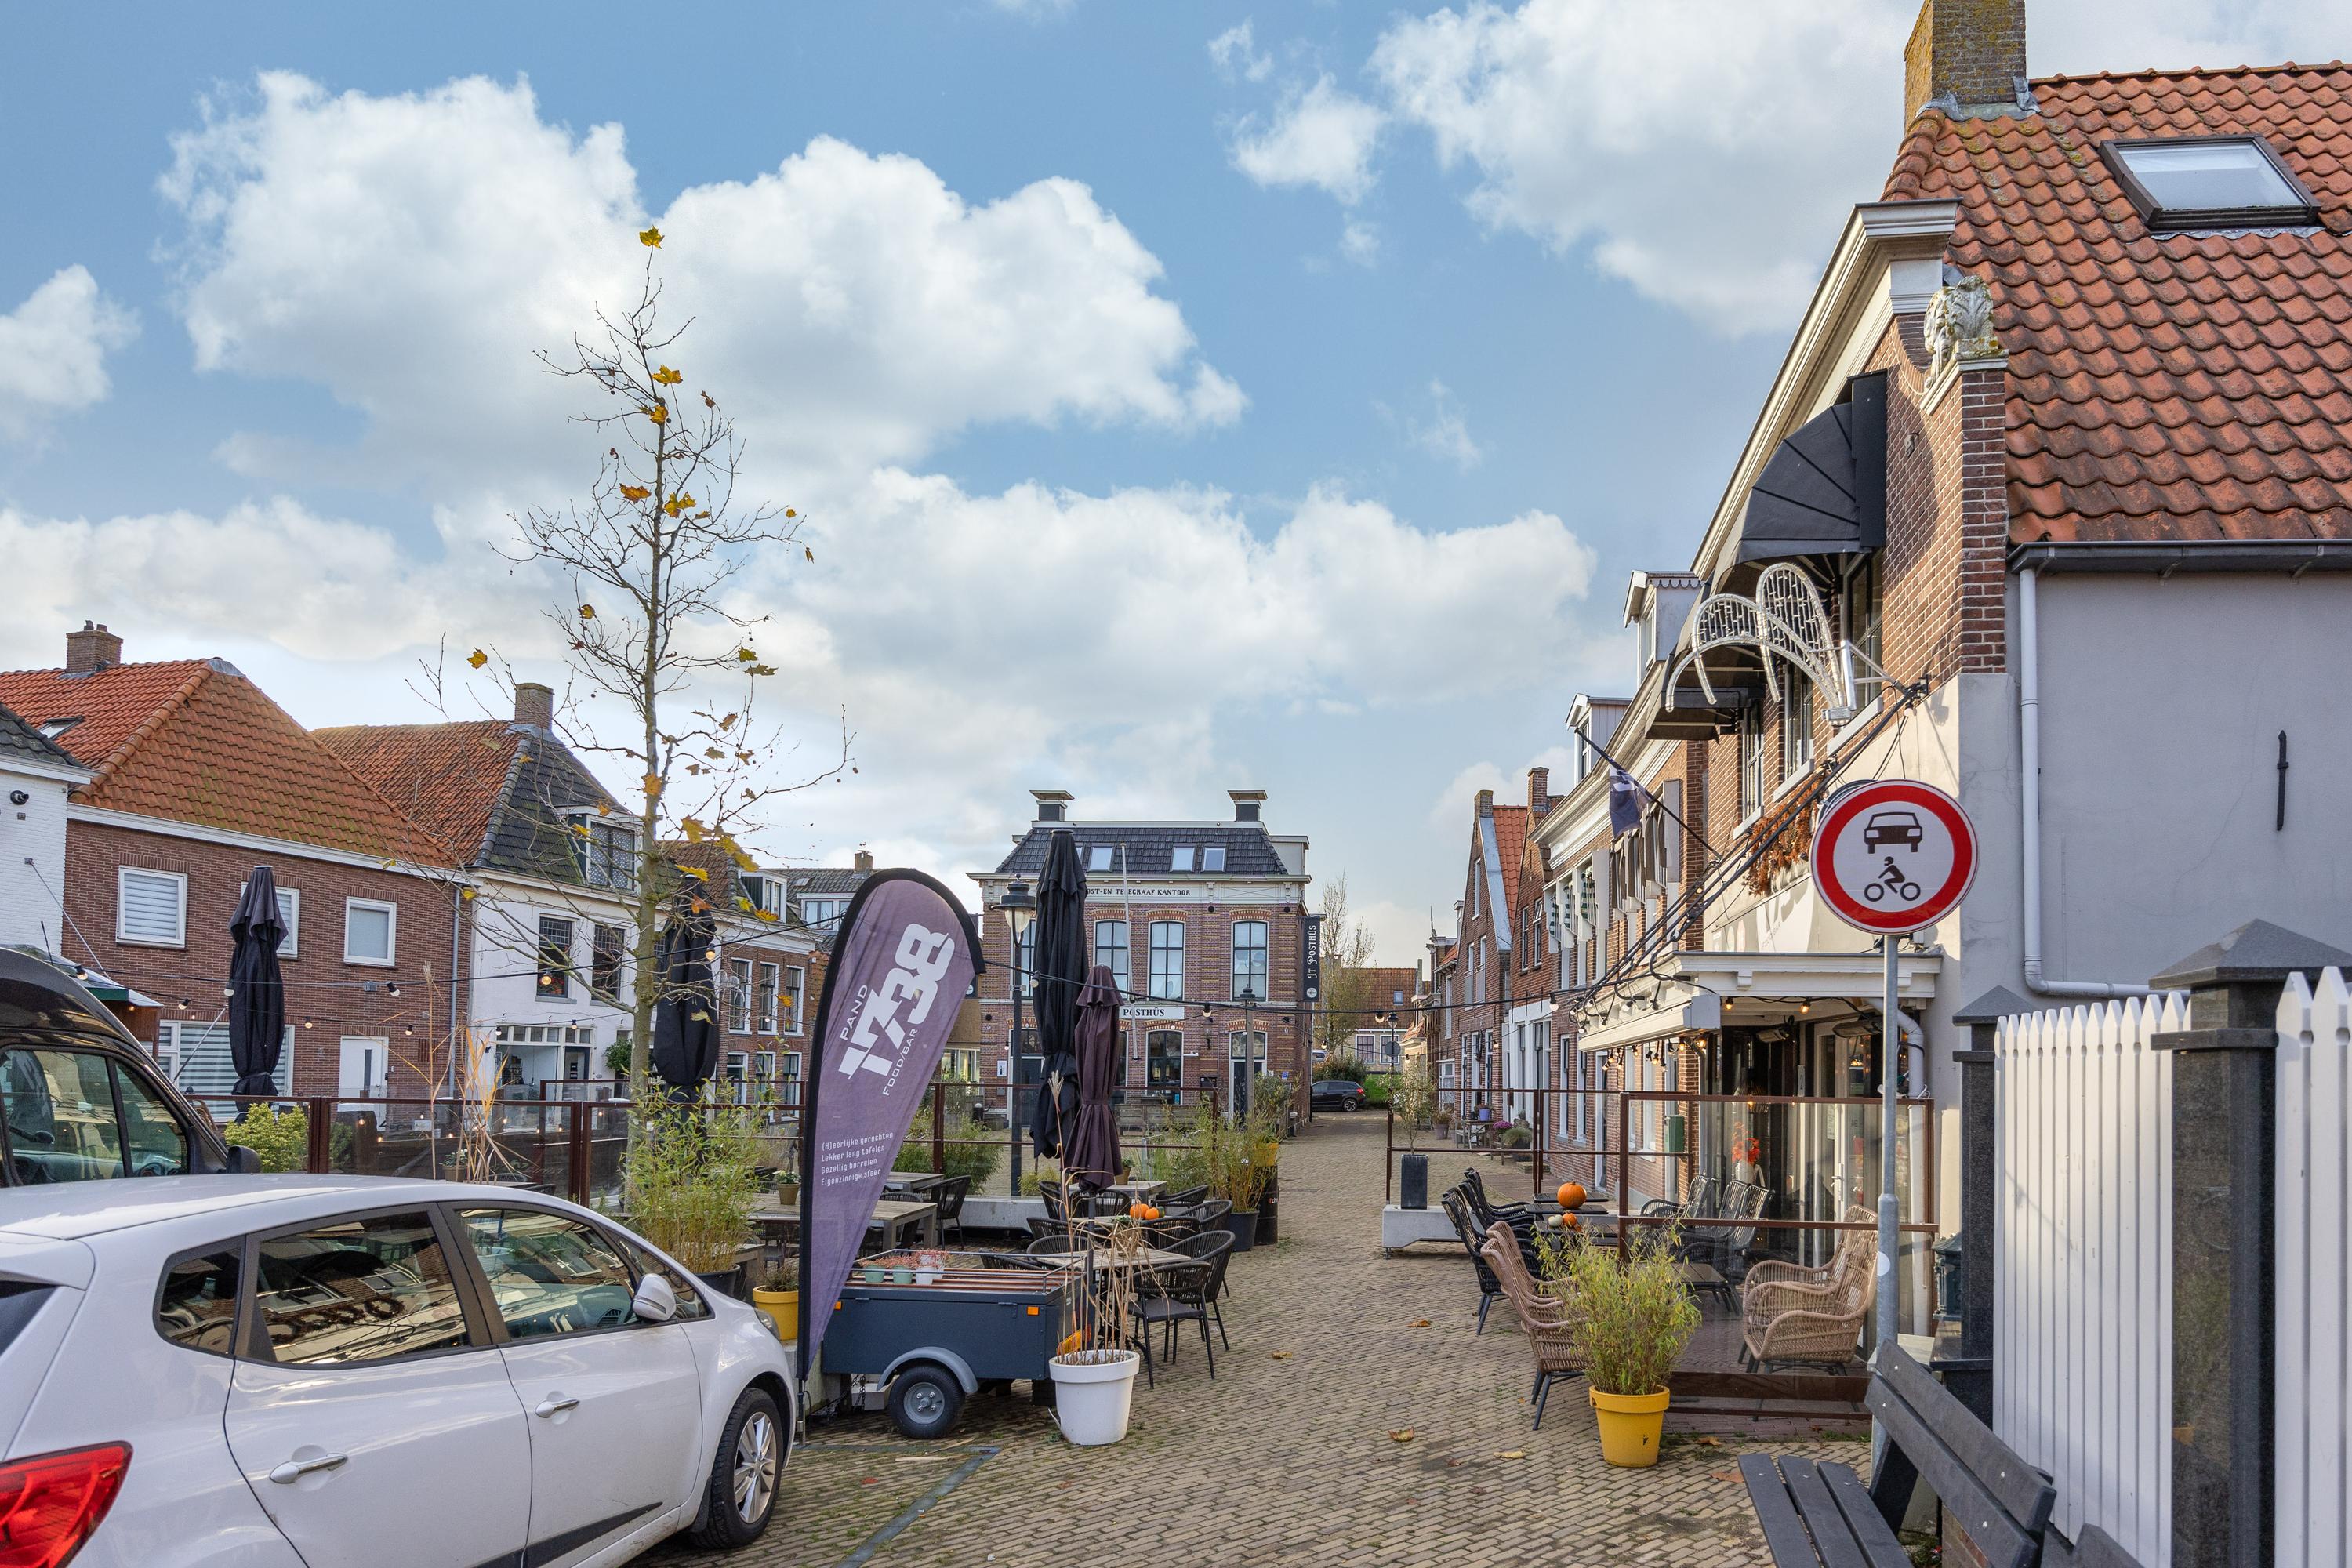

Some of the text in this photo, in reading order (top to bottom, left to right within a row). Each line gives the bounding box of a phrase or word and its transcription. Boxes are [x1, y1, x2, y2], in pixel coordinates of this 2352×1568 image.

[838, 923, 956, 1080] 1738
[840, 985, 869, 1041] PAND
[882, 1029, 918, 1096] FOOD/BAR
[822, 1132, 894, 1152] (H)eerlijke gerechten
[822, 1145, 885, 1162] Lekker lang tafelen
[821, 1158, 877, 1174] Gezellig borrelen
[821, 1168, 881, 1187] Eigenzinnige sfeer
